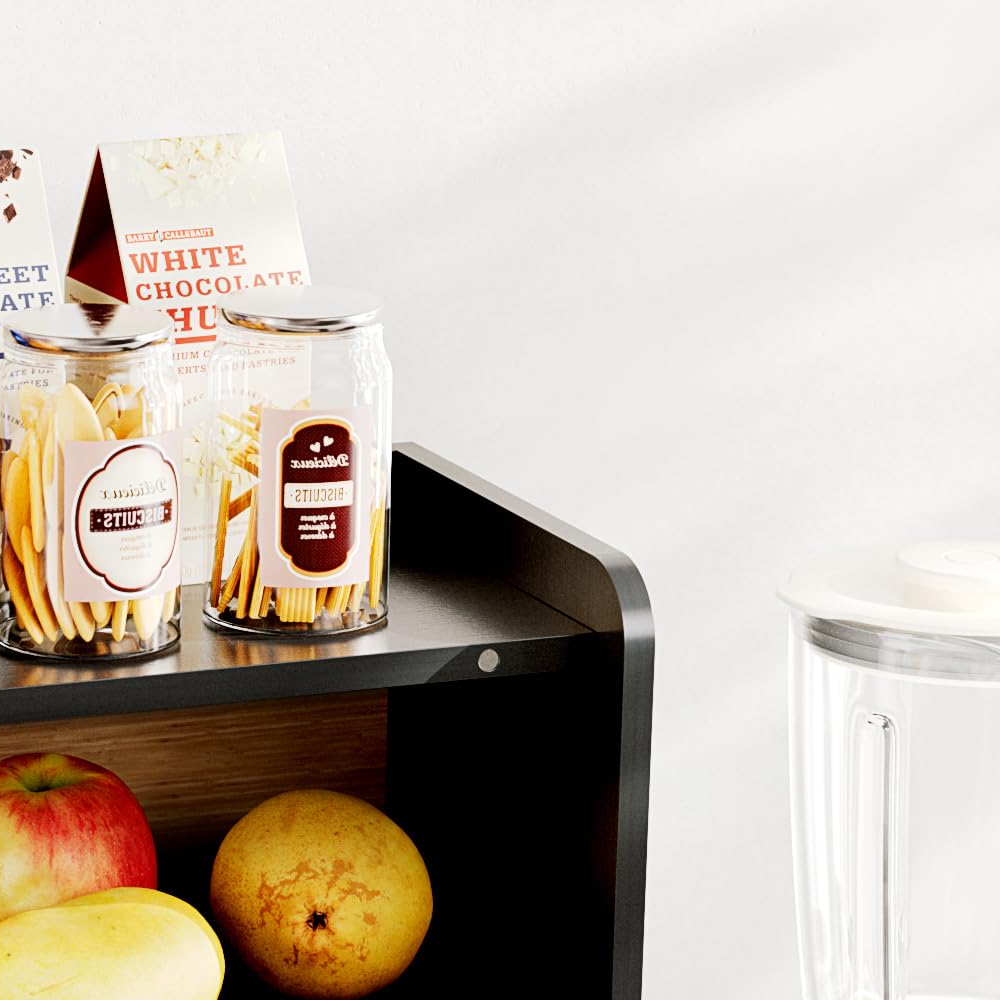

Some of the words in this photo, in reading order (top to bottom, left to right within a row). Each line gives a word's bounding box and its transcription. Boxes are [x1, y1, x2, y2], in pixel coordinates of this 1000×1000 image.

[126, 233, 156, 243] BARRY
[164, 228, 213, 241] CALLEBAUT
[129, 244, 247, 274] WHITE
[135, 270, 304, 301] CHOCOLATE
